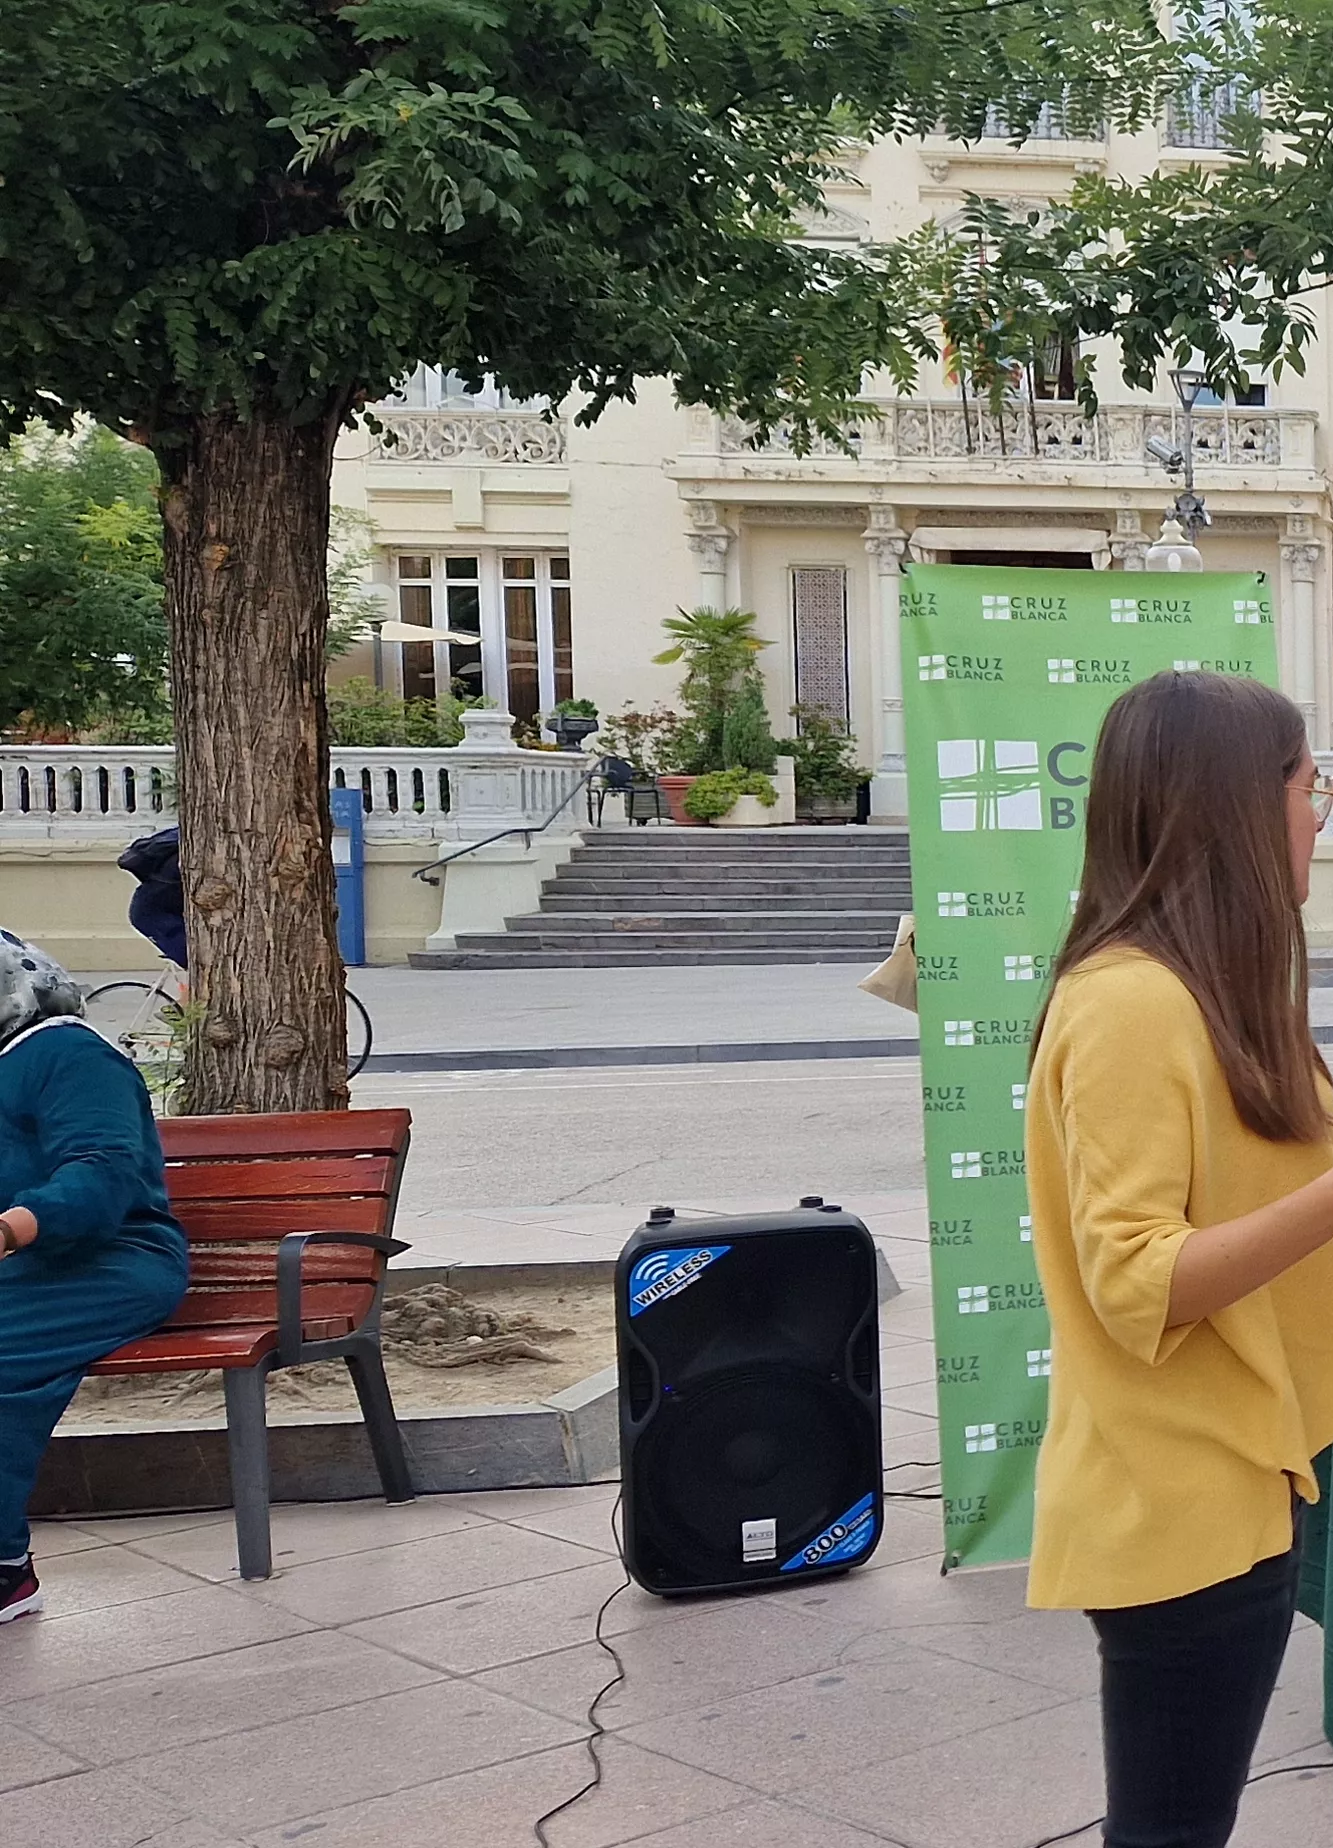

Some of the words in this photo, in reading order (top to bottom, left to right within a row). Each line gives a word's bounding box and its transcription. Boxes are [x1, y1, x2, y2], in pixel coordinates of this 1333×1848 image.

[1010, 596, 1067, 610] CRUZ
[1137, 599, 1192, 613] CRUZ
[1010, 610, 1068, 621] BLANCA
[1138, 613, 1193, 624] BLANCA
[946, 655, 1003, 670] CRUZ
[1075, 659, 1132, 672] CRUZ
[1200, 660, 1253, 673] CRUZ
[946, 669, 1005, 682] BLANCA
[1075, 673, 1132, 684] BLANCA
[966, 892, 1026, 905] CRUZ
[967, 905, 1026, 917] BLANCA
[973, 1020, 1033, 1033] CRUZ
[974, 1033, 1031, 1045] BLANCA
[636, 1251, 713, 1305] WIRELESS
[803, 1523, 846, 1564] 800
